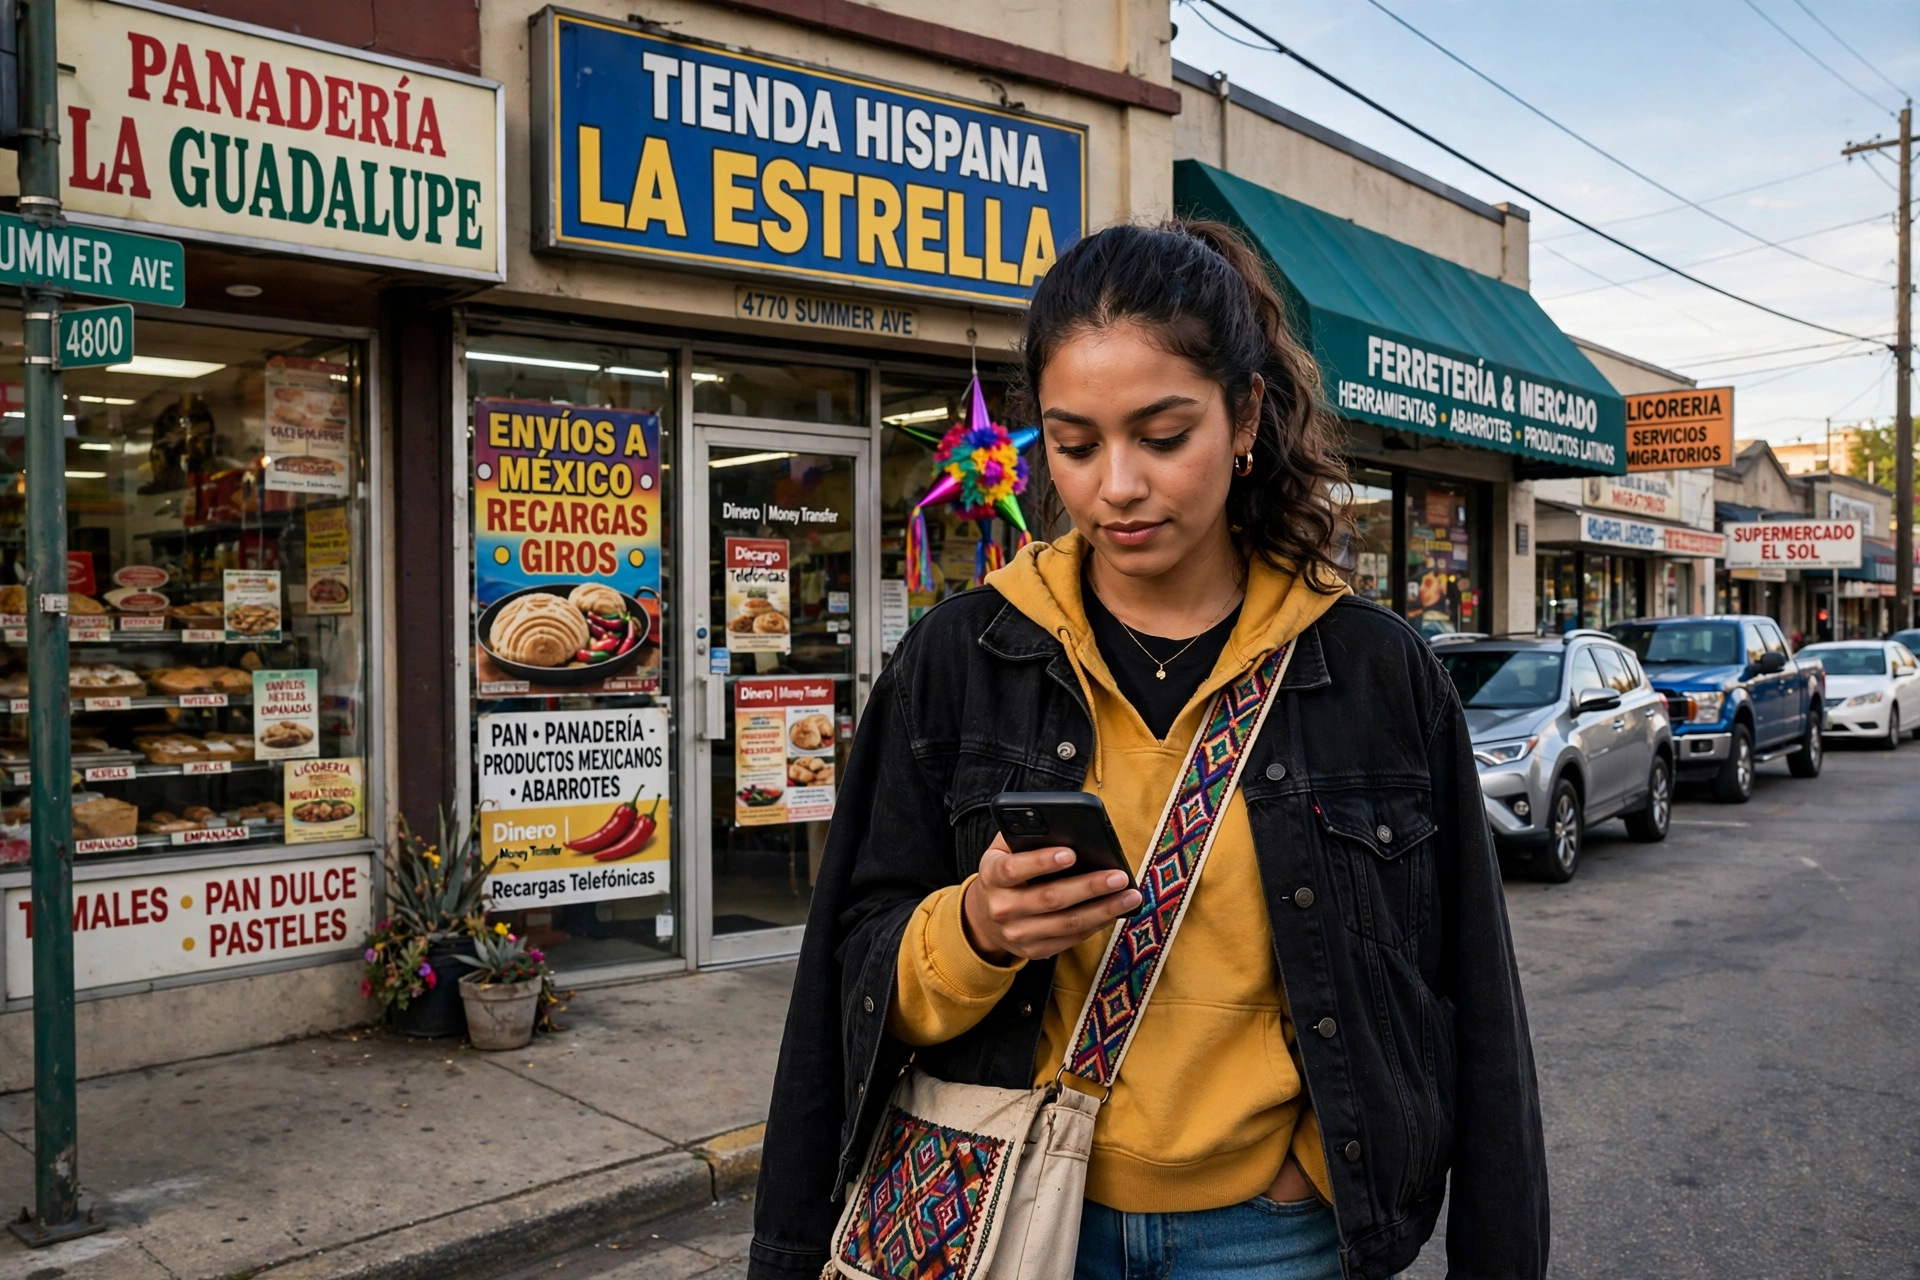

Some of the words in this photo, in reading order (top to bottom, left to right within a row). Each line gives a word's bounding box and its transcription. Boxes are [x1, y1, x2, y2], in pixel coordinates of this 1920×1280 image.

[128, 31, 446, 158] PANADERÍA
[643, 51, 842, 153] TIENDA
[855, 97, 1049, 193] HISPANA
[68, 105, 151, 199] LA
[169, 126, 482, 250] GUADALUPE
[577, 125, 687, 237] LA
[712, 147, 1058, 288] ESTRELLA
[129, 256, 174, 291] AVE
[742, 292, 788, 319] 4770
[795, 298, 874, 330] SUMMER
[880, 308, 912, 335] AVE
[66, 316, 123, 358] 4800
[1368, 335, 1497, 409] FERRETERÍA
[1501, 375, 1515, 413] &
[1519, 380, 1598, 433] MERCADO
[1338, 379, 1437, 428] HERRAMIENTAS
[1449, 408, 1512, 444] ABARROTES
[1524, 425, 1579, 459] PRODUCTOS
[1580, 441, 1615, 466] LATINOS
[1627, 394, 1722, 421] LICORERIA
[489, 409, 616, 456] ENVÍOS
[623, 424, 648, 458] A
[1633, 426, 1707, 447] SERVICIOS
[499, 449, 633, 497] MÉXICO
[1626, 445, 1722, 466] MIGRATORIOS
[487, 498, 648, 537] RECARGAS
[723, 502, 761, 520] Dinero
[768, 505, 800, 526] Money
[800, 507, 839, 523] Transfer
[1734, 524, 1855, 543] SUPERMERCADO
[521, 538, 618, 575] GIROS
[1761, 544, 1780, 560] EL
[1786, 544, 1820, 560] SOL
[740, 686, 773, 700] Dinero
[492, 723, 527, 747] PAN
[545, 714, 644, 744] PANADERÍA
[484, 751, 574, 776] PRODUCTOS
[579, 746, 662, 771] MEXICANOS
[522, 775, 621, 802] ABARROTES
[184, 827, 246, 843] EMPANADAS
[493, 821, 557, 844] Dinero
[492, 877, 566, 899] Recargas
[570, 869, 655, 891] Telefónicas
[19, 886, 168, 939] TMALES
[205, 877, 260, 915] PAN
[270, 867, 357, 908] DULCE
[209, 908, 347, 958] PASTELES
